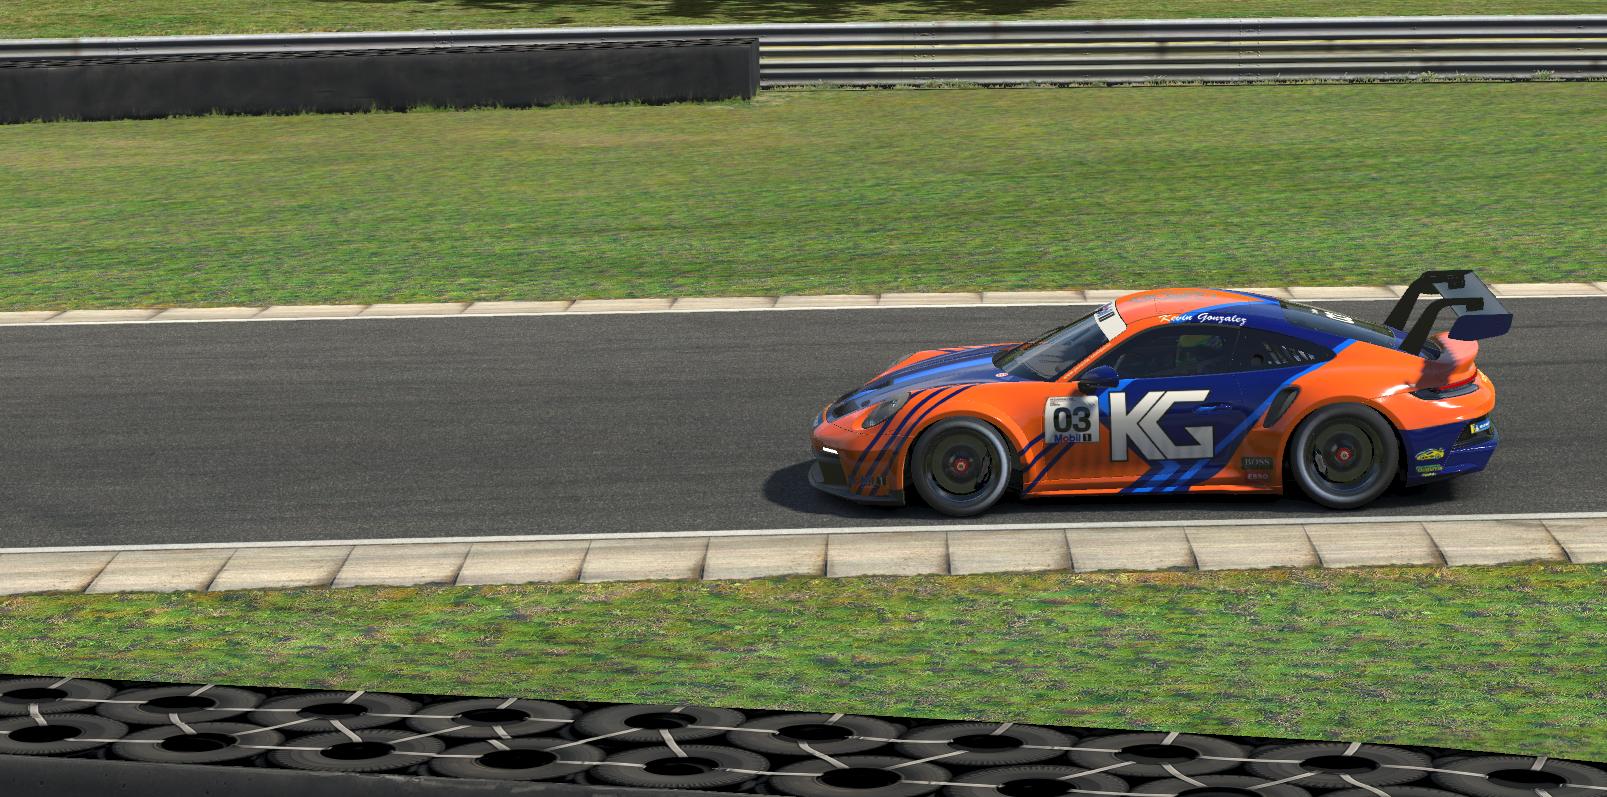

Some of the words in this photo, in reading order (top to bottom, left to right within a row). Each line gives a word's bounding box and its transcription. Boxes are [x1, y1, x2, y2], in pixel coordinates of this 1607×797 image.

[1157, 313, 1193, 323] Kevin
[1197, 312, 1247, 326] Gonzalez
[1053, 406, 1092, 432] 03
[1109, 389, 1214, 462] KG
[1054, 433, 1082, 443] Mobil
